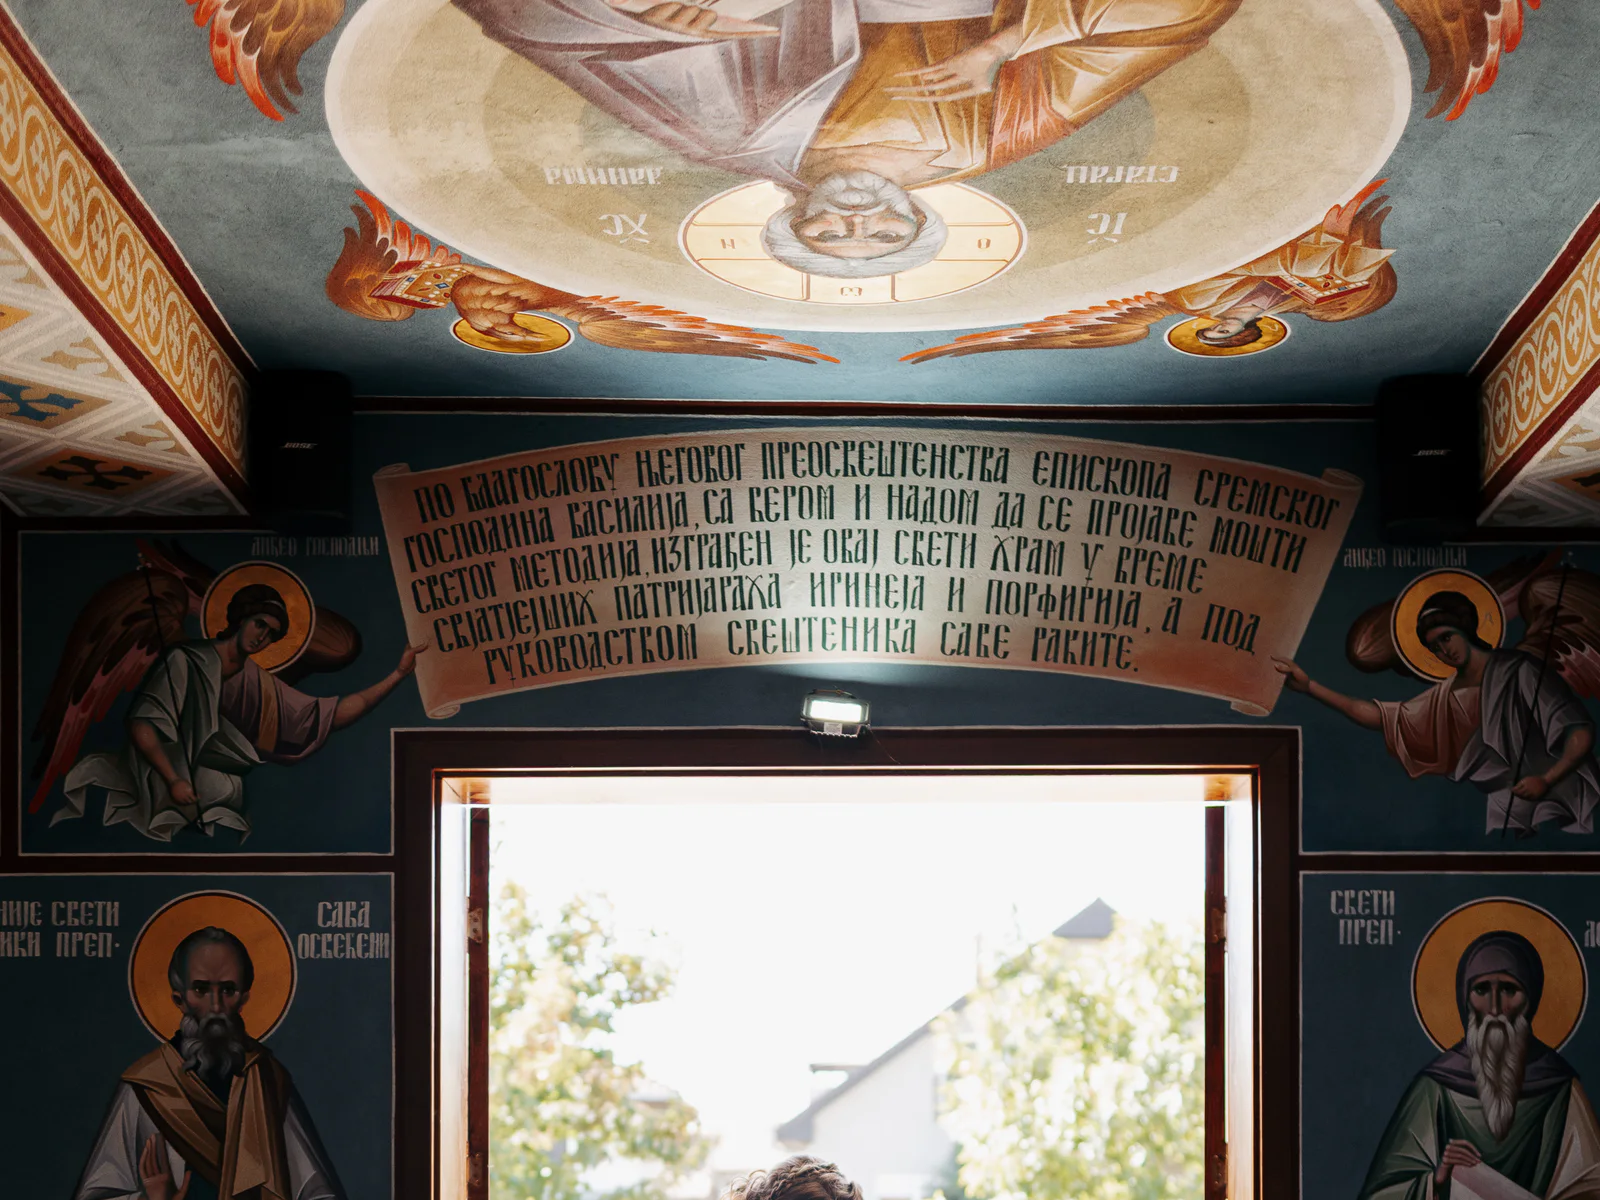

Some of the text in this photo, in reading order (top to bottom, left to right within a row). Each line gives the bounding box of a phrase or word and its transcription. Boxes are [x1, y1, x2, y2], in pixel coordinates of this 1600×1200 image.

[413, 438, 1341, 532] ПО БЛАГОСЛОВУ ЊЕГОВОГ ПРЕОСВЕШТЕНСТВА ЕПИСКОПА СРЕМСКОГ
[402, 507, 555, 573] ГОСПОДИНА
[703, 487, 734, 526] СА
[748, 484, 835, 523] ВЕРОМ
[854, 483, 872, 521] И
[887, 482, 979, 527] НАДОМ
[991, 490, 1025, 533] ДА
[1037, 495, 1073, 533] СЕ
[1087, 498, 1199, 549] ПРОЈАВЕ
[1209, 514, 1308, 574] МОШТИ
[411, 559, 497, 615] СВЕТОГ
[790, 528, 812, 569] ЈЕ
[823, 527, 879, 572] ОВАЈ
[894, 528, 977, 569] СВЕТИ
[990, 534, 1066, 577] ХРАМ
[1080, 541, 1105, 585] У
[1114, 546, 1205, 594] ВРЕМЕ
[482, 616, 1140, 685] РУКОВОДСТВОМ СВЕШТЕНИКА САВЕ РАКИТЕ.
[614, 573, 781, 622] ПАТРИЈАРАХА
[809, 571, 925, 616] ИРИНЕЈА
[947, 576, 965, 613] И
[1161, 597, 1179, 635] А
[1202, 603, 1262, 656] ПОД
[51, 900, 120, 927] СВЕТИ
[317, 900, 371, 929] САВА
[1330, 889, 1396, 916] СВЕТИ
